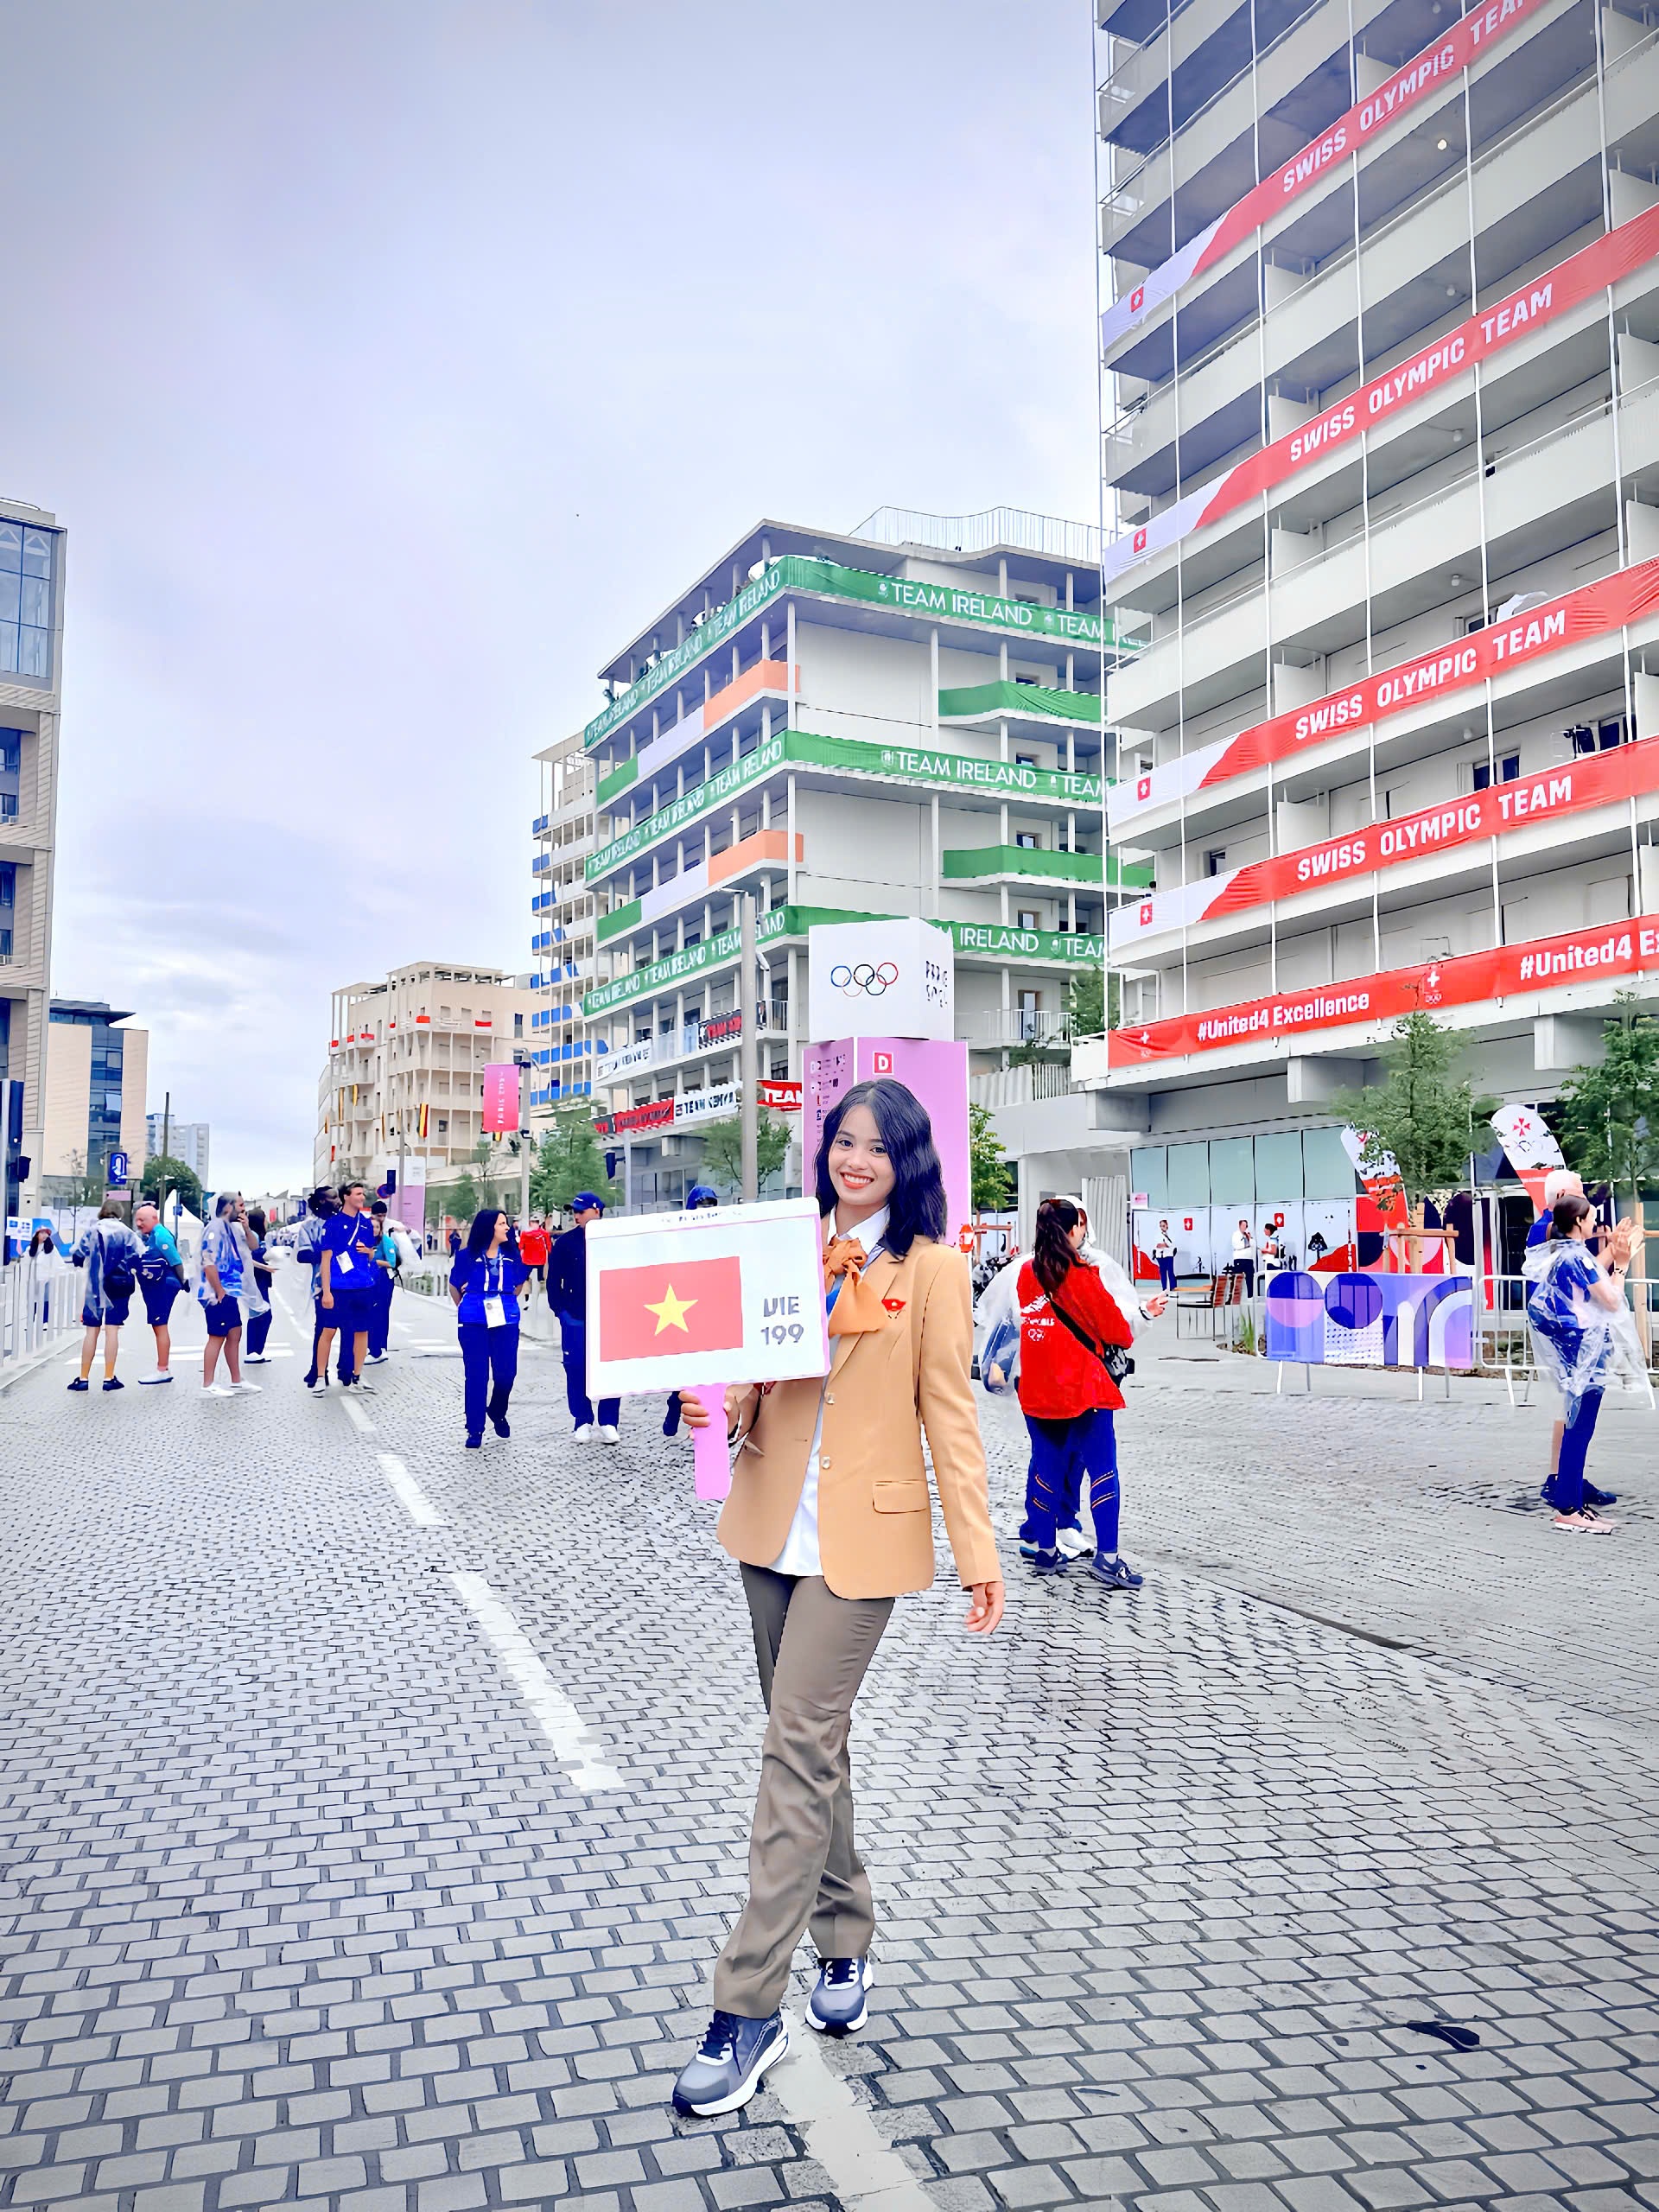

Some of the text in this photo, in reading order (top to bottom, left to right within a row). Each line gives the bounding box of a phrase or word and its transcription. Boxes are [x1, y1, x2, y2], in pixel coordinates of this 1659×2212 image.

[1283, 128, 1347, 194] SWISS
[1360, 44, 1455, 131] OLYMPIC
[1290, 283, 1553, 462] SWISS OLYMPIC TEAM
[739, 570, 780, 618] IRELAND
[891, 582, 946, 611] TEAM
[952, 594, 1033, 626] IRELAND
[1296, 609, 1566, 741] SWISS OLYMPIC TEAM
[896, 750, 950, 777] TEAM
[957, 760, 1037, 789] IRELAND
[1298, 776, 1572, 881] SWISS OLYMPIC TEAM
[960, 927, 1039, 952] IRELAND
[1198, 1009, 1268, 1042] #United4
[1273, 993, 1370, 1027] Excellence
[1521, 934, 1632, 981] #United4
[760, 1324, 804, 1345] 199
